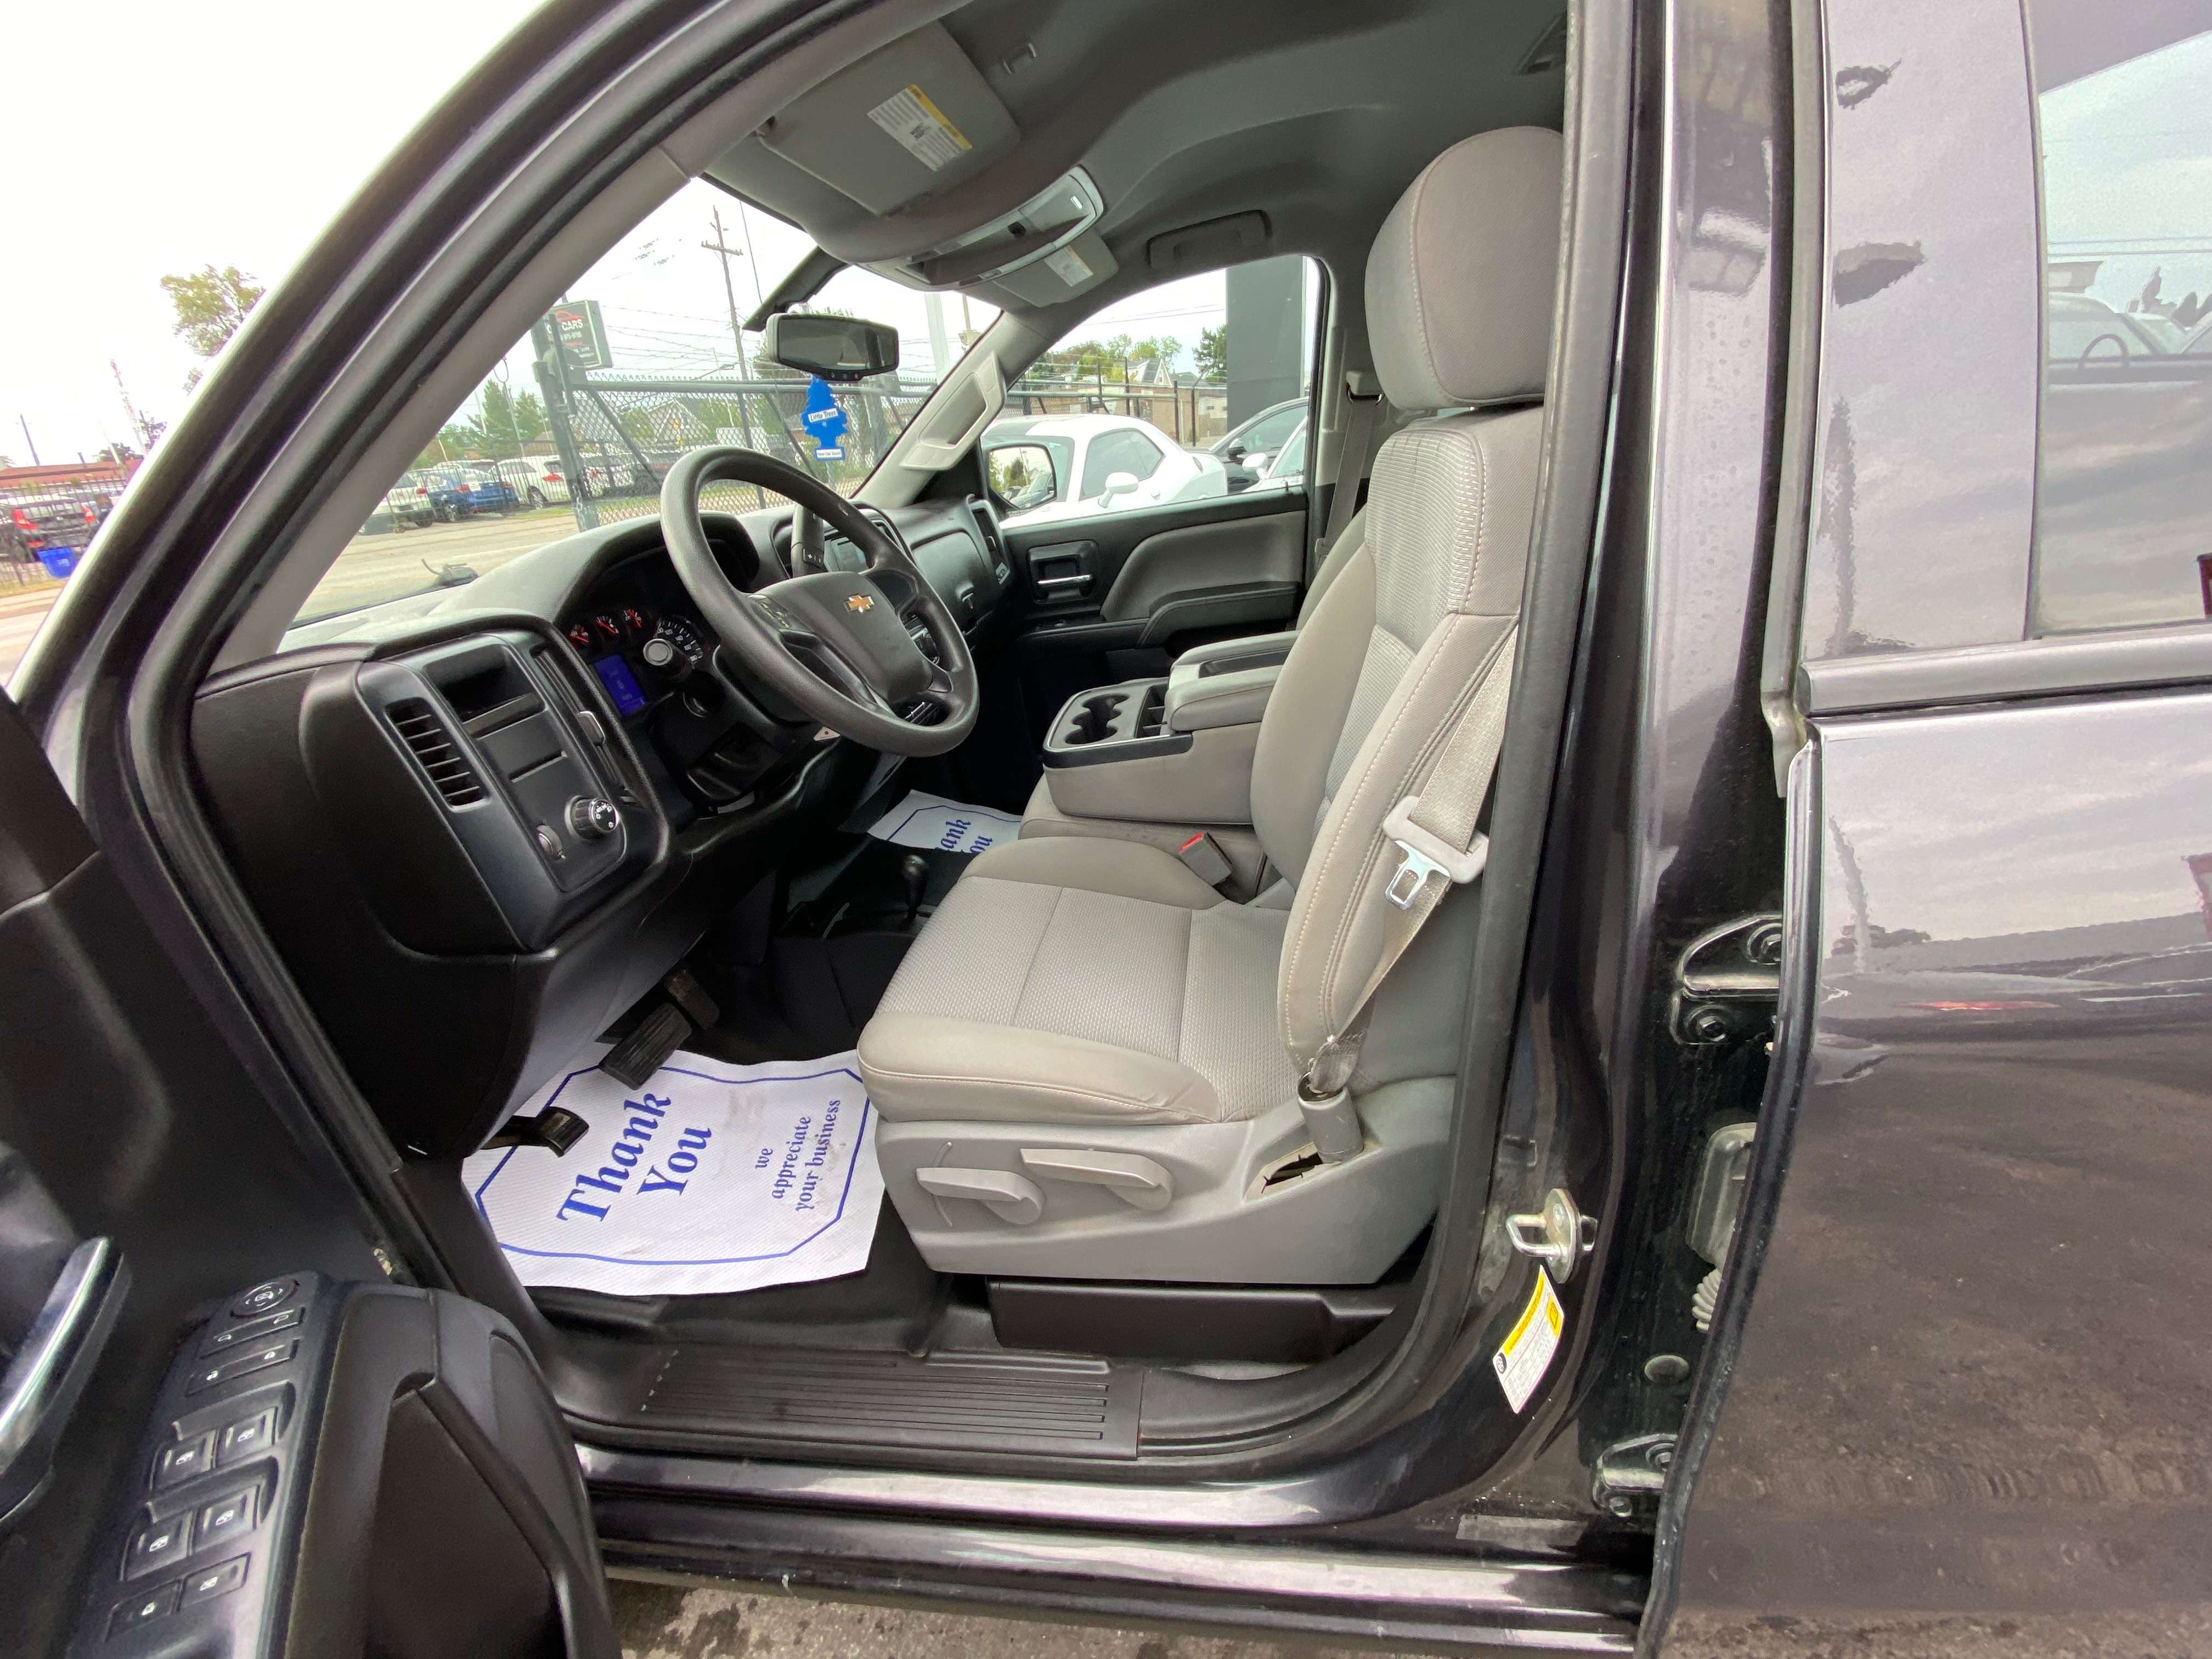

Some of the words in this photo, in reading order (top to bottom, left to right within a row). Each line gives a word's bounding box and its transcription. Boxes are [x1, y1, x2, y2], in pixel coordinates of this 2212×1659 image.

[561, 319, 583, 331] CARS
[937, 819, 971, 850] ank
[968, 836, 993, 855] ou
[804, 1099, 841, 1167] business
[556, 1092, 672, 1222] Thank
[636, 1126, 712, 1196] You
[755, 1148, 773, 1170] we
[771, 1116, 811, 1199] appreciate
[795, 1170, 819, 1211] your
